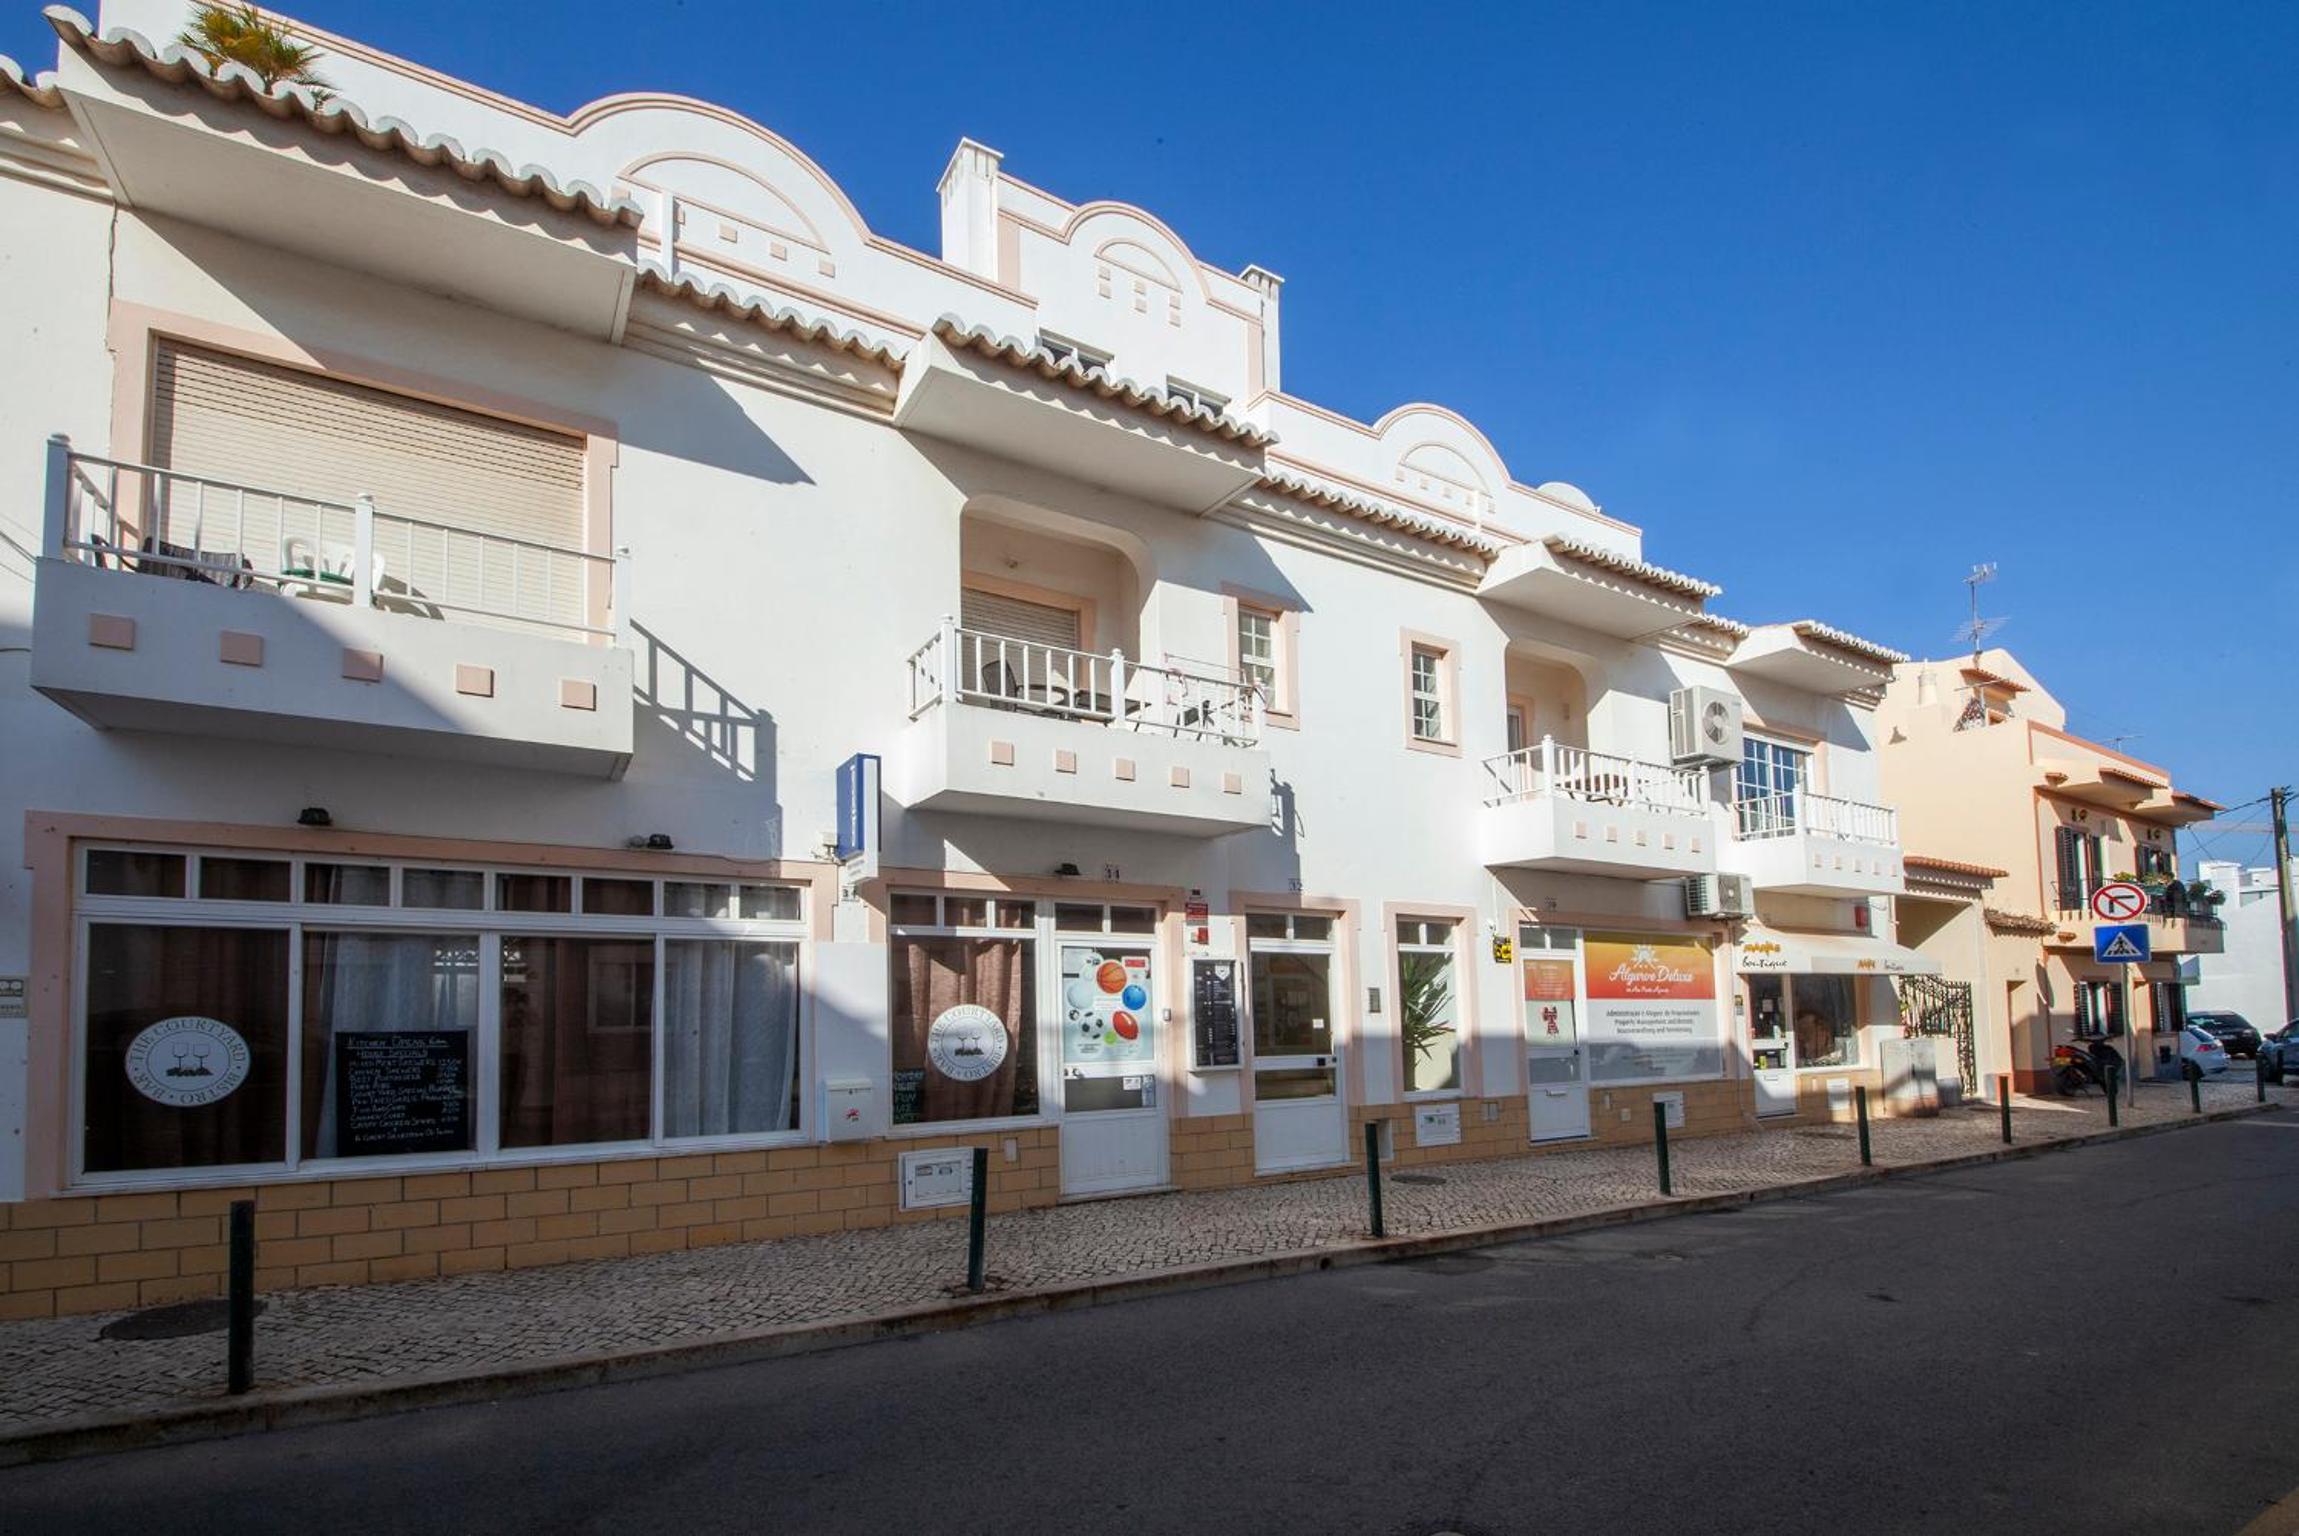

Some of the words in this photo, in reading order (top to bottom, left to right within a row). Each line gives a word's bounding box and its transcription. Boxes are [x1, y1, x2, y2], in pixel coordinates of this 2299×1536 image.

[1609, 964, 1656, 986] Algarve
[1656, 965, 1693, 983] Deluxe
[133, 1035, 152, 1061] THE
[154, 1019, 247, 1061] COURTYARD
[134, 1072, 166, 1099] BAR
[180, 1071, 241, 1104] BISTRO
